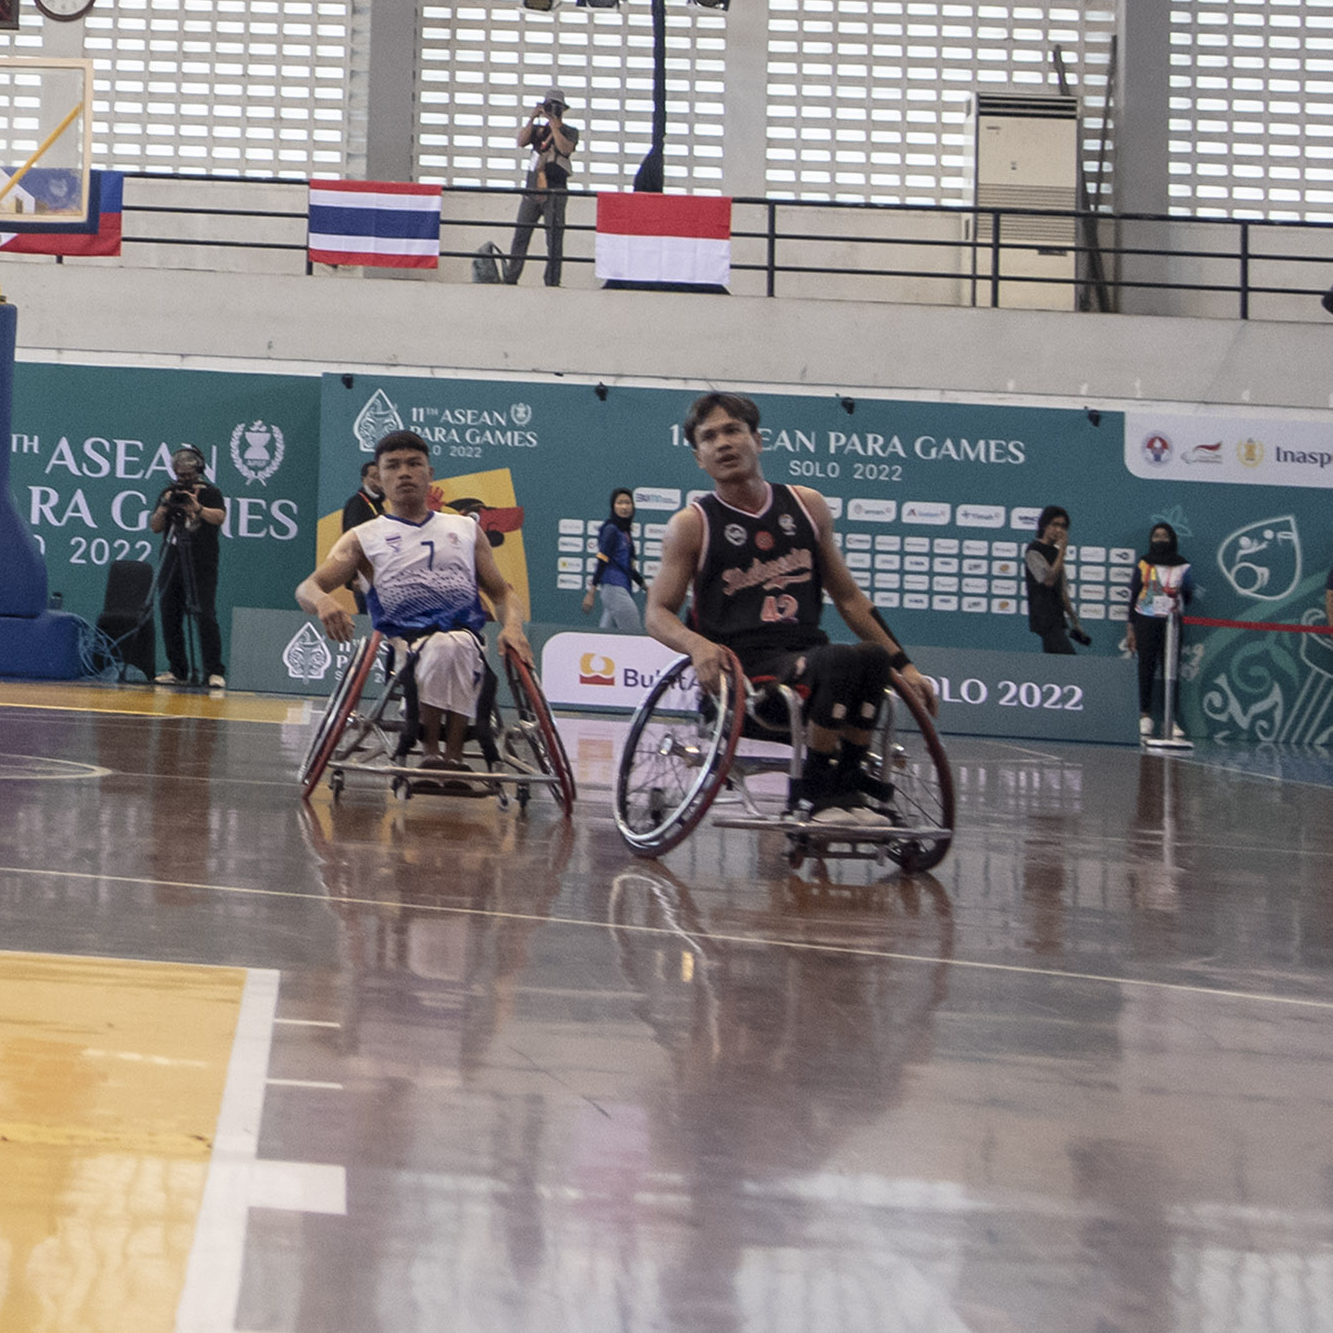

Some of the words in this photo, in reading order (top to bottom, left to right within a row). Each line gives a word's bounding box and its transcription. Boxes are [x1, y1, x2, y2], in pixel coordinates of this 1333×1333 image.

[440, 408, 506, 427] ASEAN
[465, 428, 538, 448] GAMES
[828, 431, 907, 458] PARA
[914, 435, 1026, 464] GAMES
[789, 460, 840, 478] SOLO
[853, 463, 903, 481] 2022
[69, 536, 152, 566] 2022
[421, 540, 435, 571] 7
[997, 679, 1084, 711] 2022
